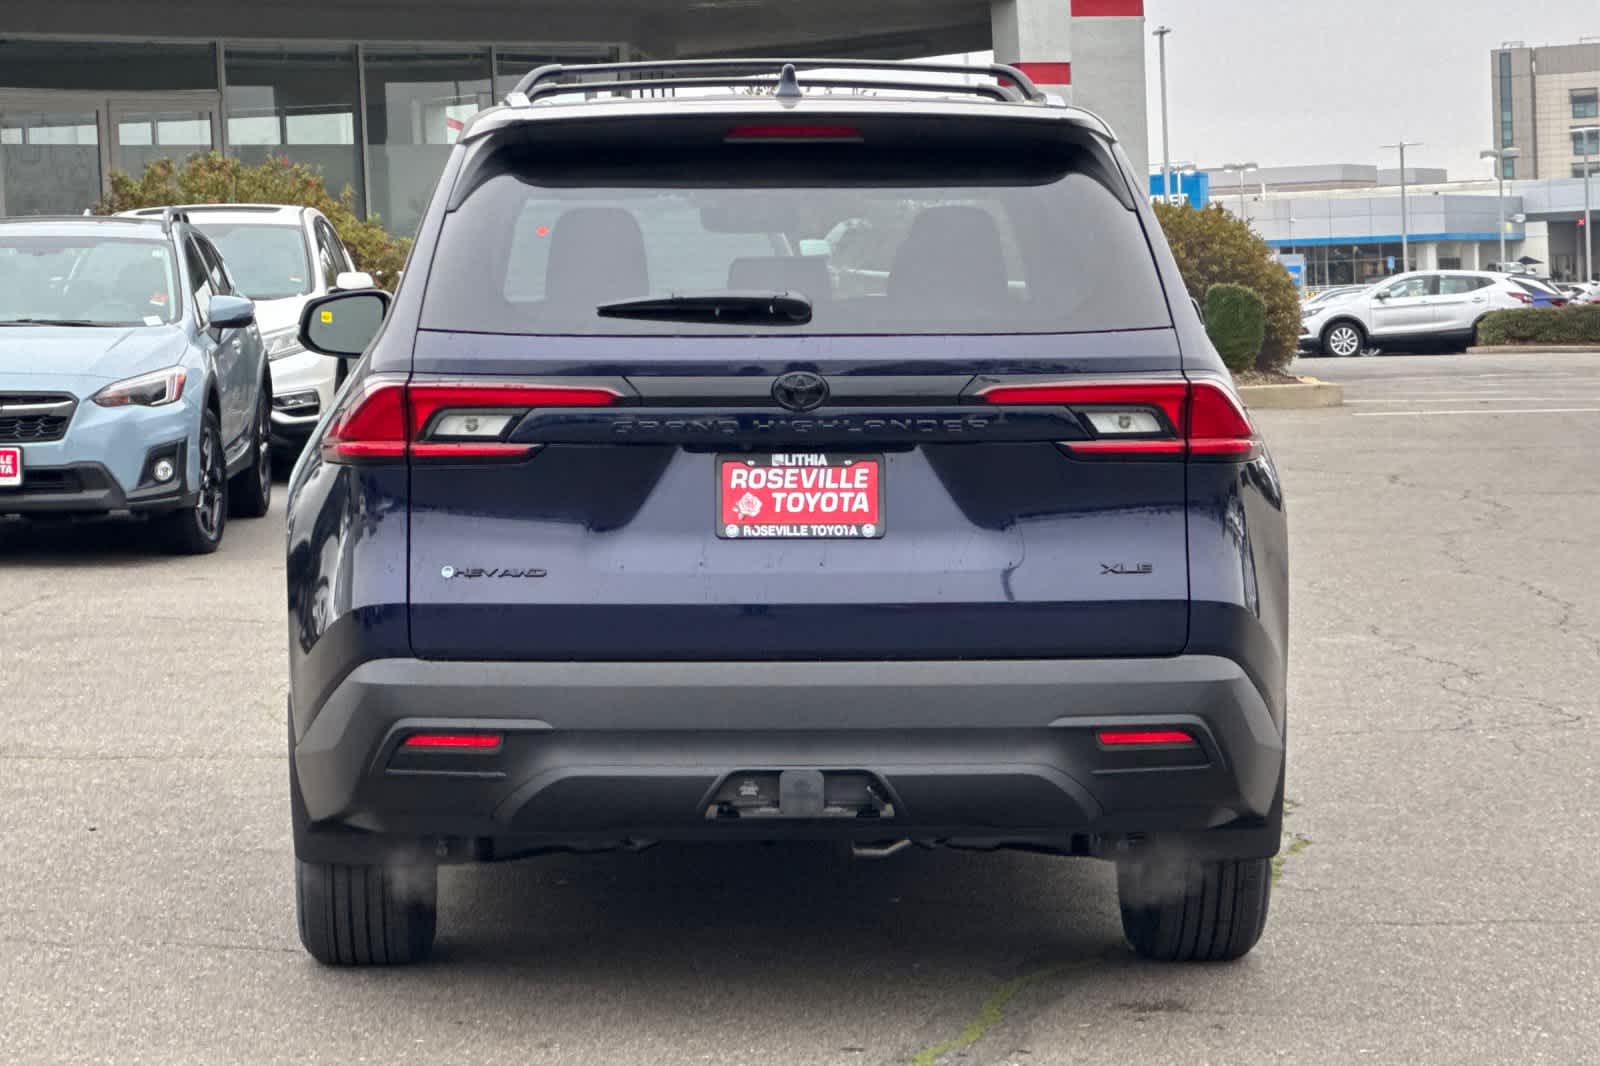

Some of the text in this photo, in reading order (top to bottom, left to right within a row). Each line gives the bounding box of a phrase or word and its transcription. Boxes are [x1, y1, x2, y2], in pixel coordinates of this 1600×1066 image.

[612, 418, 989, 433] GRAND HIGHLANDER
[785, 454, 828, 466] LITHIA
[730, 468, 870, 489] ROSEVILLE
[771, 492, 870, 513] TOYOTA
[743, 526, 858, 536] ROSEVILLE TOYOTA
[1100, 563, 1153, 575] XLE
